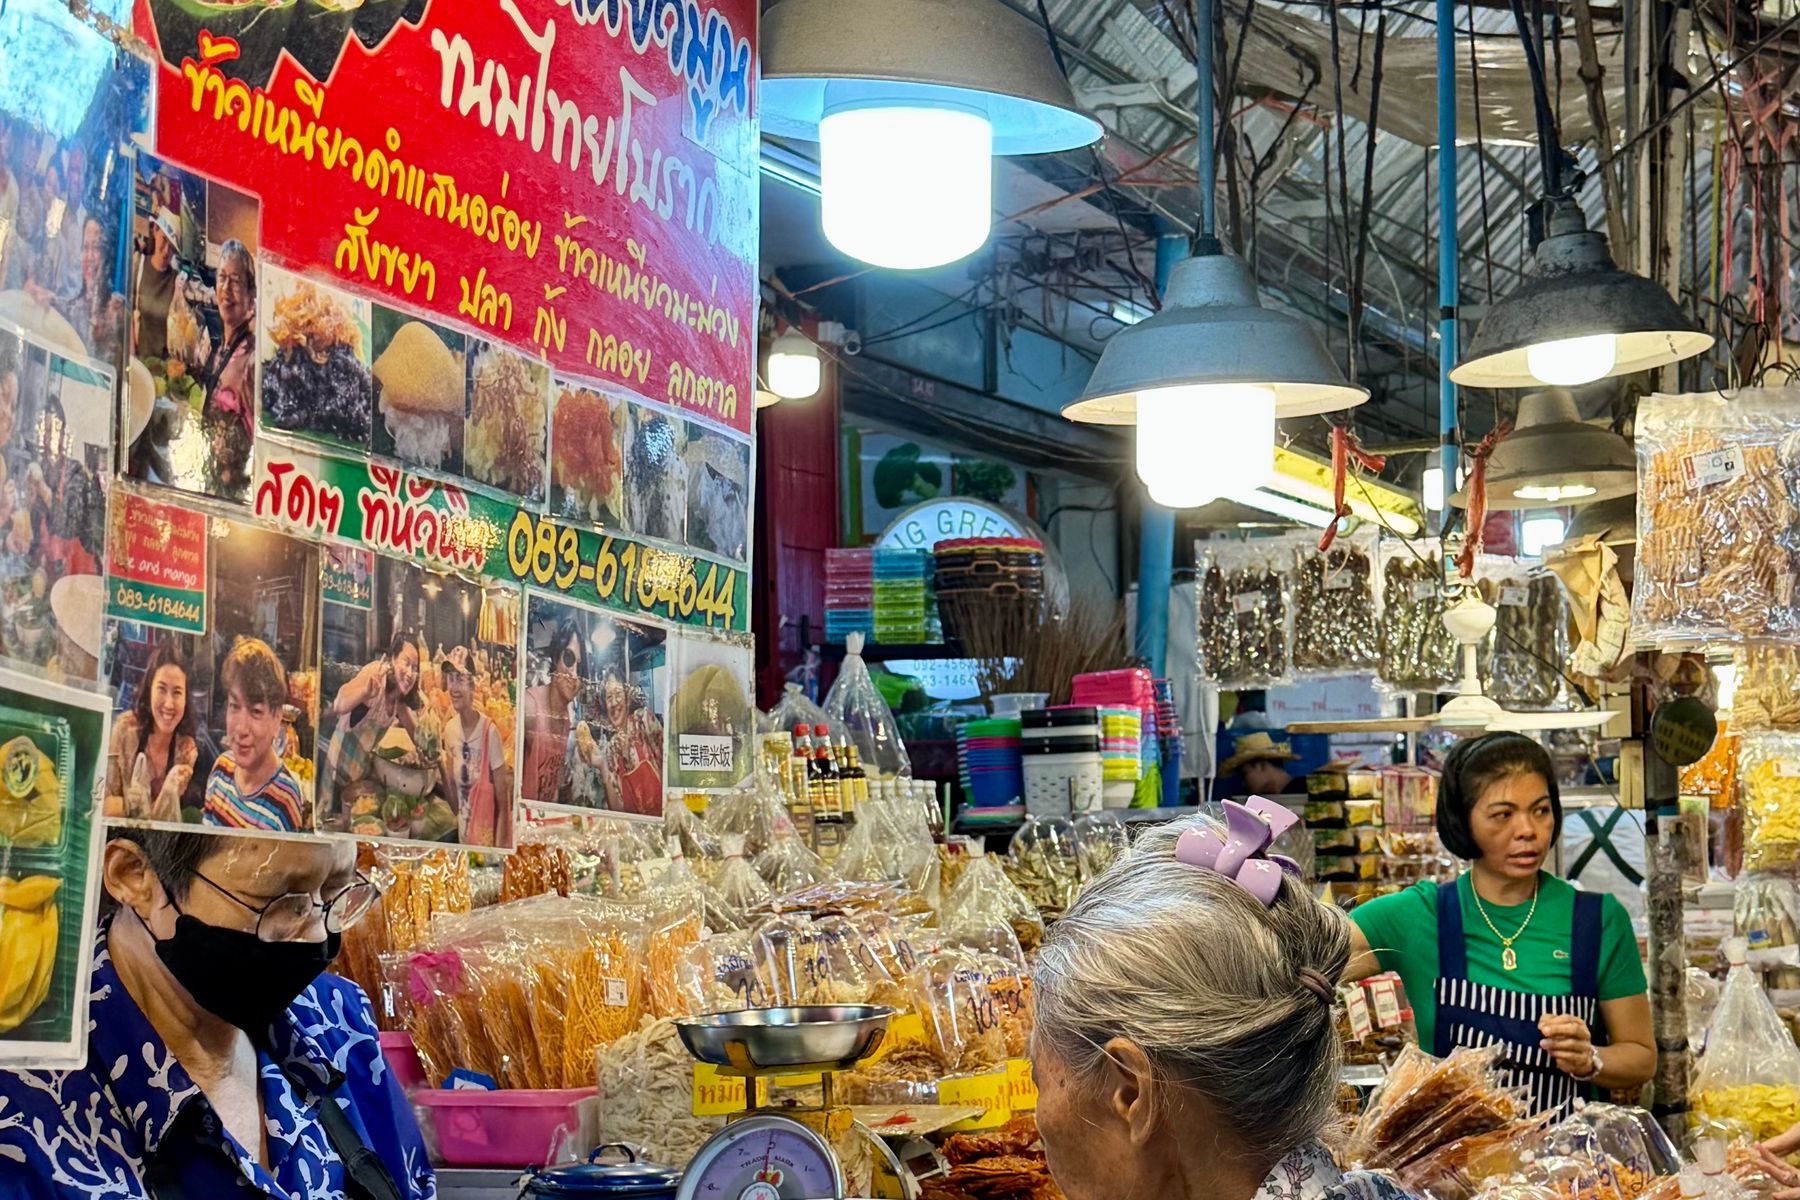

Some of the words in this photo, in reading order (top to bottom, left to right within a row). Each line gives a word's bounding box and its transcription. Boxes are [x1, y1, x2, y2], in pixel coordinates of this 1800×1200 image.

[458, 267, 512, 331] ปลา
[586, 327, 651, 384] กลอย
[895, 520, 927, 550] IG
[139, 559, 160, 576] and
[163, 567, 198, 590] mango
[116, 587, 200, 623] 083-6184644
